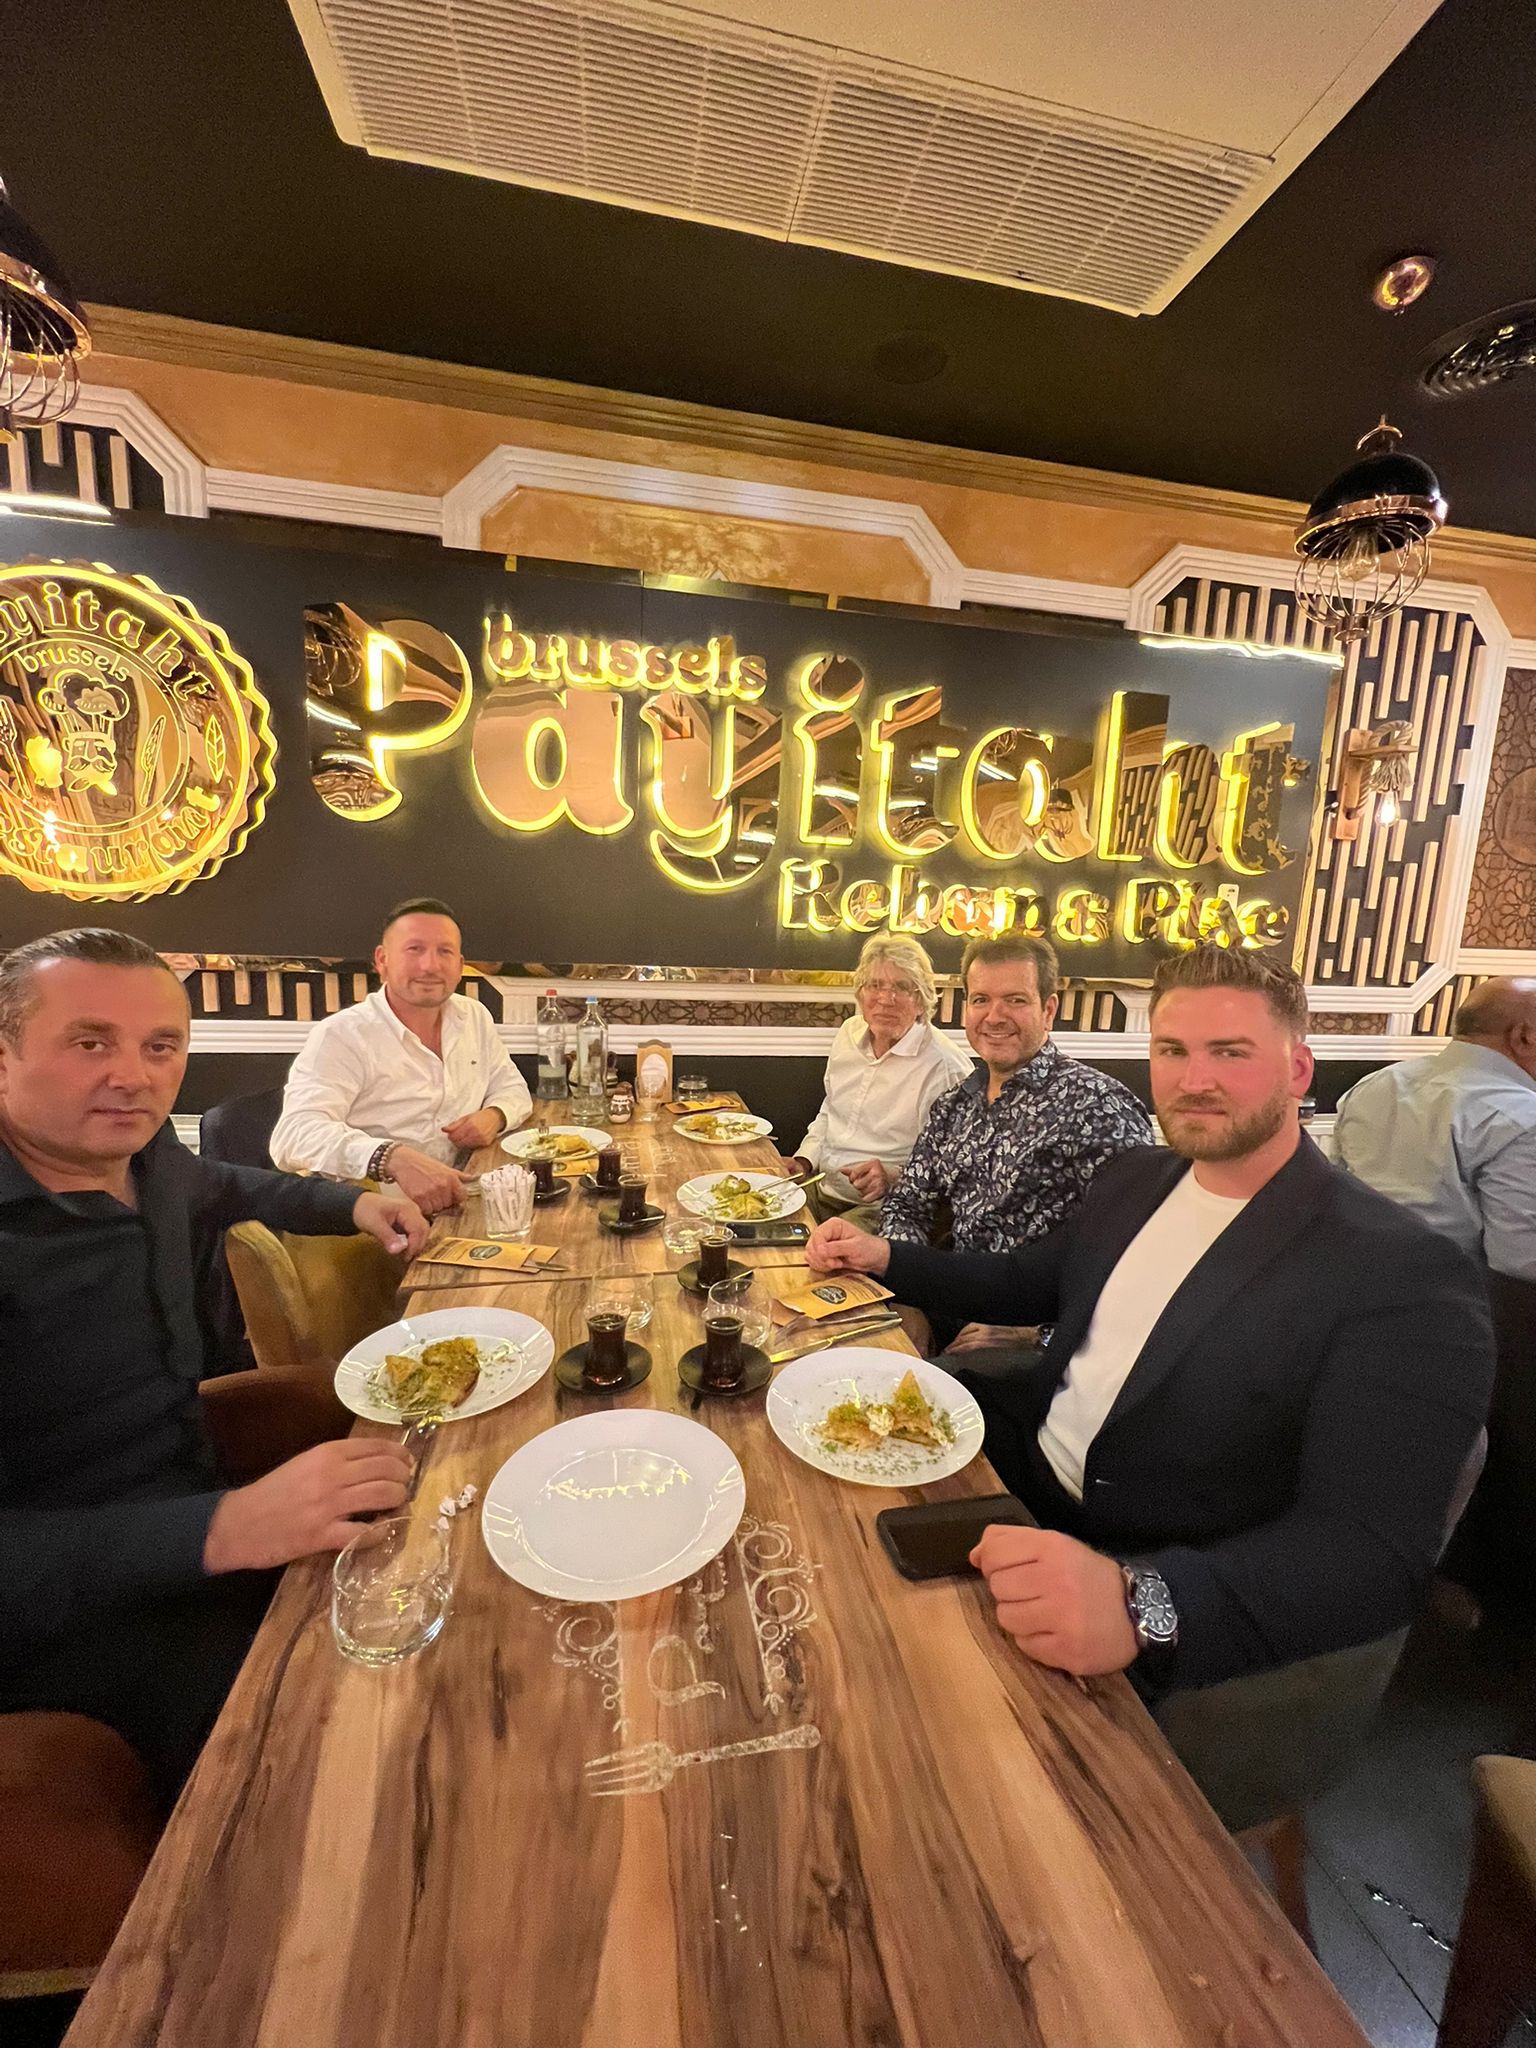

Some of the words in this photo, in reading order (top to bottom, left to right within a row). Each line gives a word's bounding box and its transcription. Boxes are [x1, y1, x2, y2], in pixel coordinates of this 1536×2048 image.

[0, 581, 215, 702] yitaht
[14, 648, 129, 682] brussels
[483, 612, 768, 701] brussels
[304, 602, 1310, 890] Payitaht
[1053, 889, 1110, 944] &
